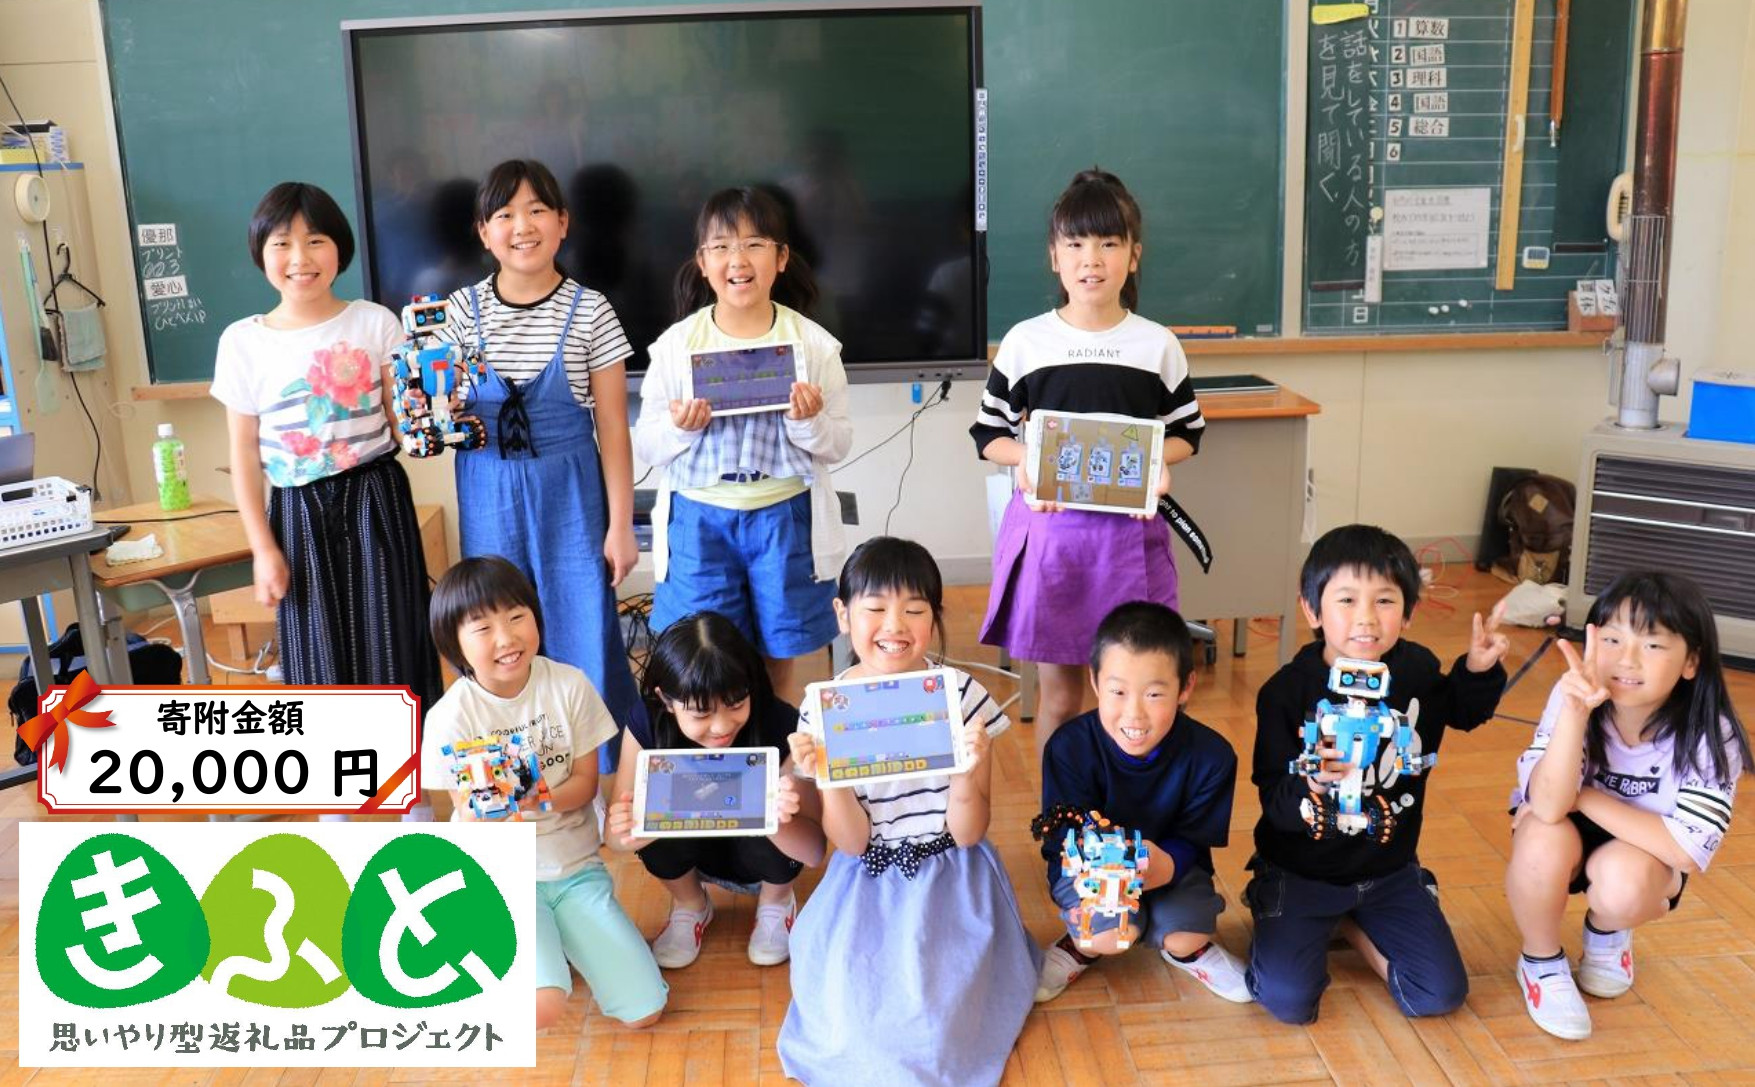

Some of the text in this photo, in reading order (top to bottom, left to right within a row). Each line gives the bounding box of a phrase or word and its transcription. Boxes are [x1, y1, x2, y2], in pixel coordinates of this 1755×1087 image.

[1397, 19, 1445, 37] 1 算数
[1394, 47, 1443, 64] 2 国語
[1392, 70, 1442, 87] 3 理科
[1390, 95, 1446, 111] 4 国語
[1390, 118, 1445, 135] 5 総合
[1389, 146, 1398, 158] 6
[150, 280, 183, 297] 愛心
[1067, 348, 1121, 359] RADIANT
